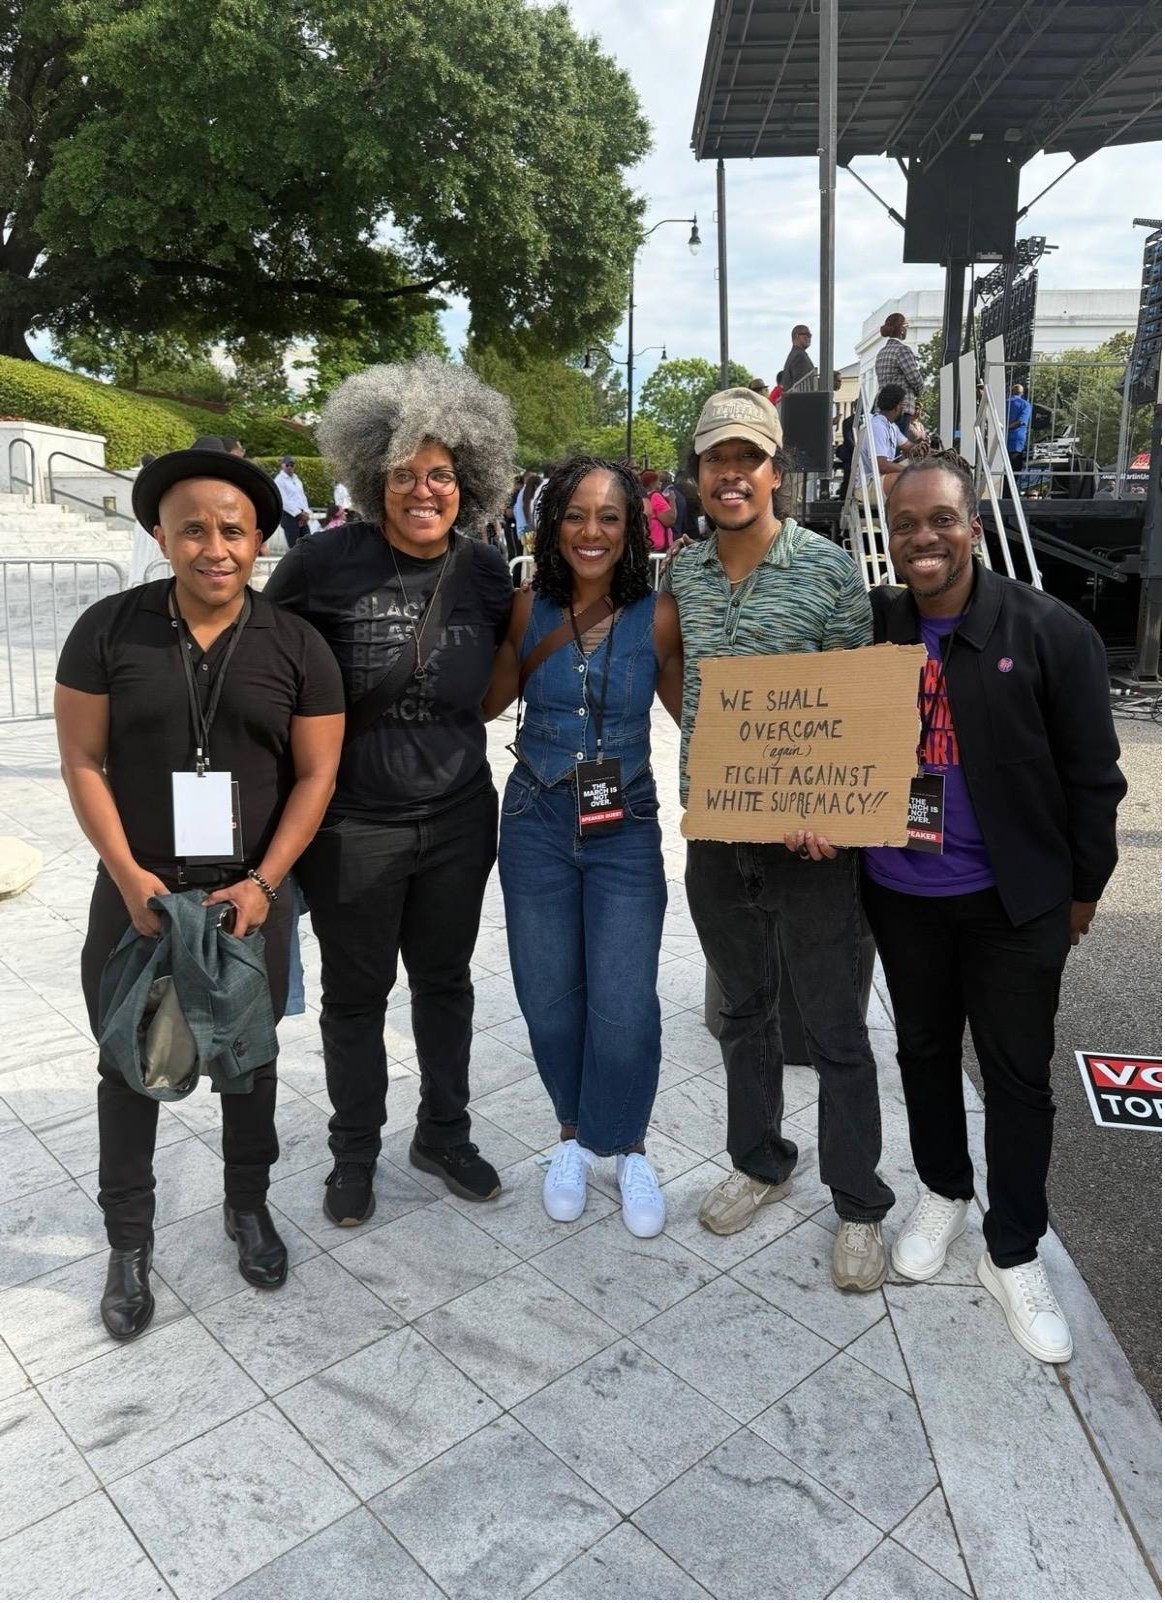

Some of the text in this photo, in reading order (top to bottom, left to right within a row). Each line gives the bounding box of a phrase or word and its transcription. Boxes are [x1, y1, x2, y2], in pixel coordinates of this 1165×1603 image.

[354, 596, 426, 619] BLAC
[720, 687, 829, 711] WE SHALL
[739, 719, 843, 743] OVERCOME
[763, 744, 812, 766] (again)
[724, 762, 876, 787] FIGHT AGAINST
[592, 782, 607, 790] THE
[583, 788, 609, 797] MARCH
[590, 799, 612, 807] OVER.
[707, 789, 889, 819] WHITE SUPREMACY!!
[911, 797, 927, 805] THE
[908, 803, 929, 812] ARCH
[911, 809, 927, 817] NOT
[907, 815, 931, 824] OVER.
[906, 830, 937, 841] PEAKER
